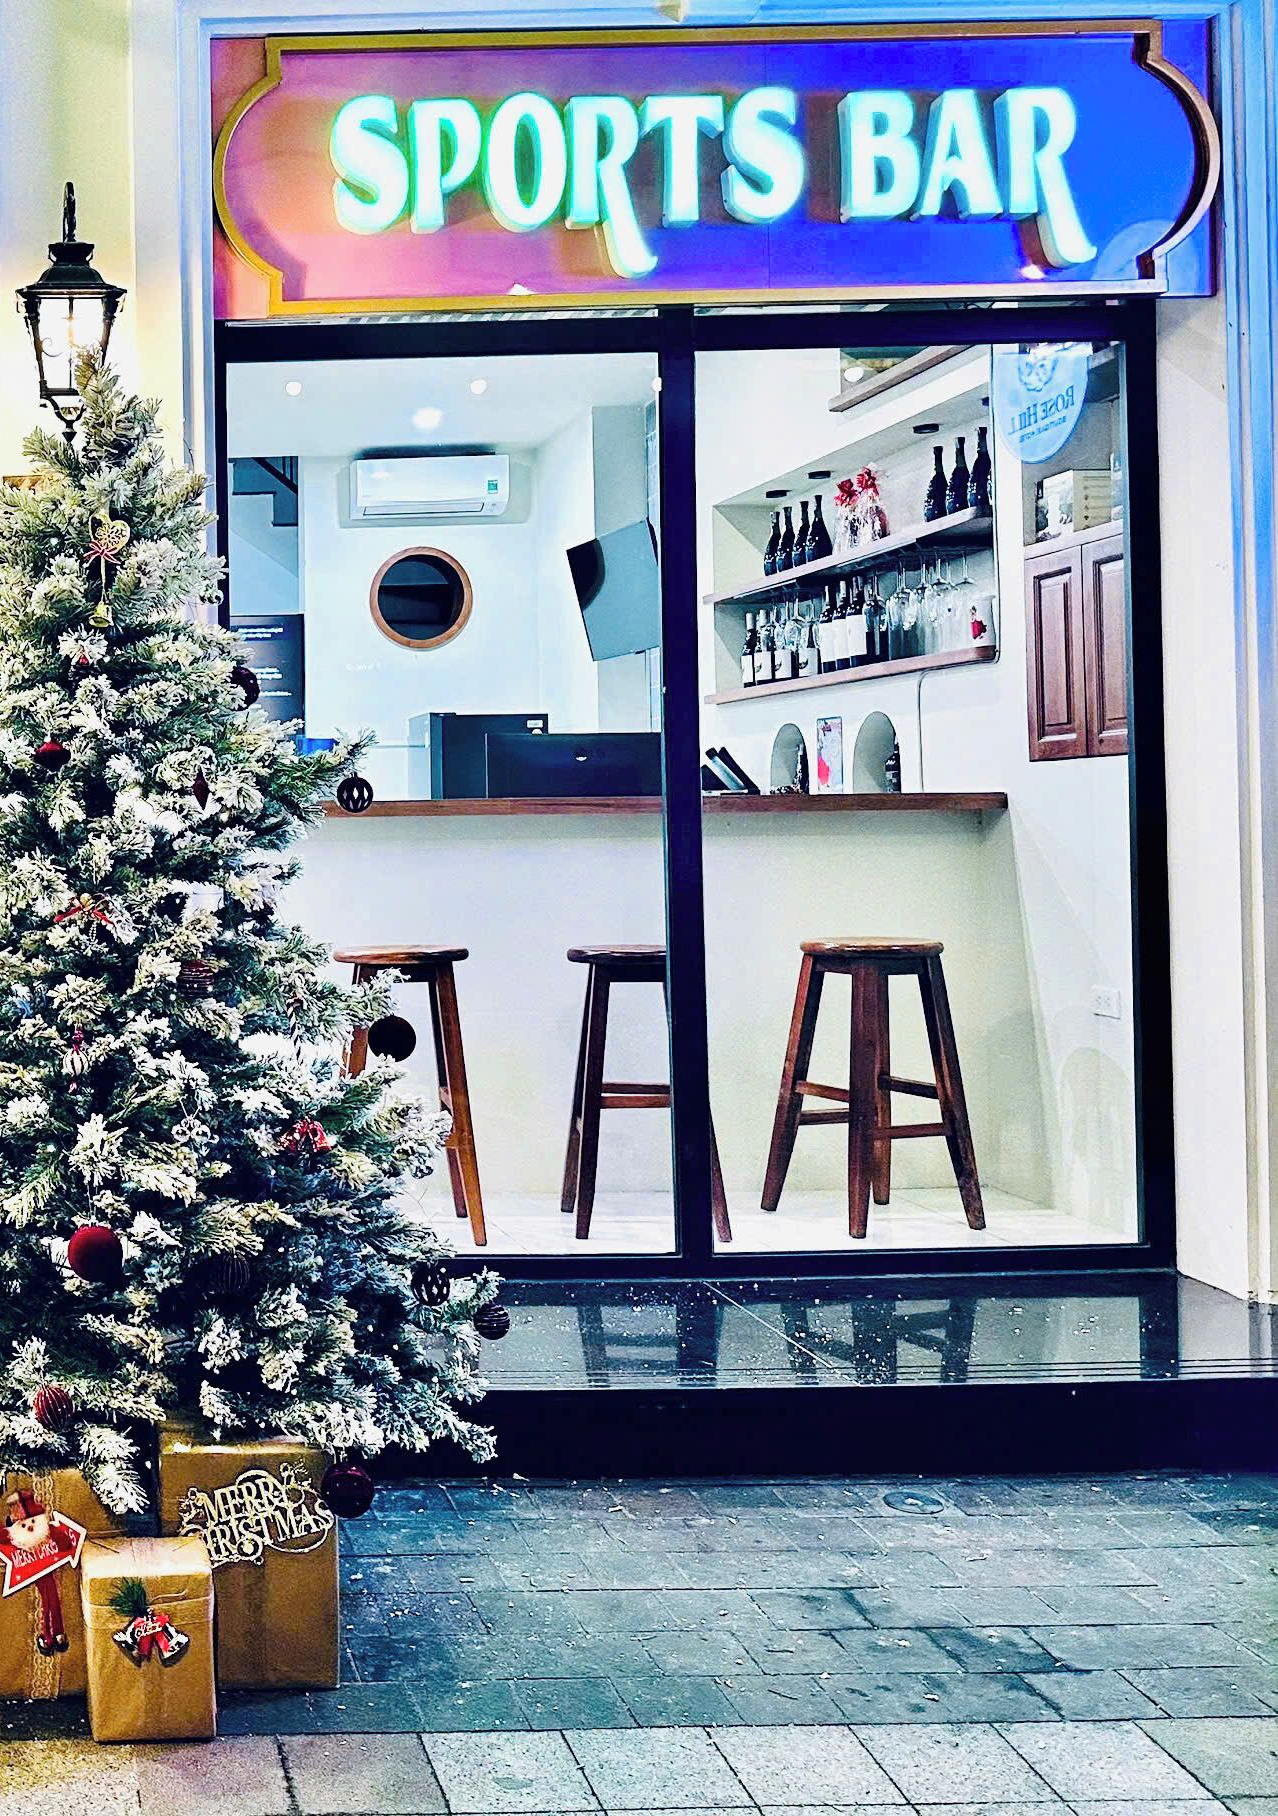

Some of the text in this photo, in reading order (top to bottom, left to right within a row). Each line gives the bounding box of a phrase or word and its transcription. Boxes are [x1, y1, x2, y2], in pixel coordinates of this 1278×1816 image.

[329, 86, 1098, 279] SPORTS BAR
[196, 1477, 304, 1526] MERRY
